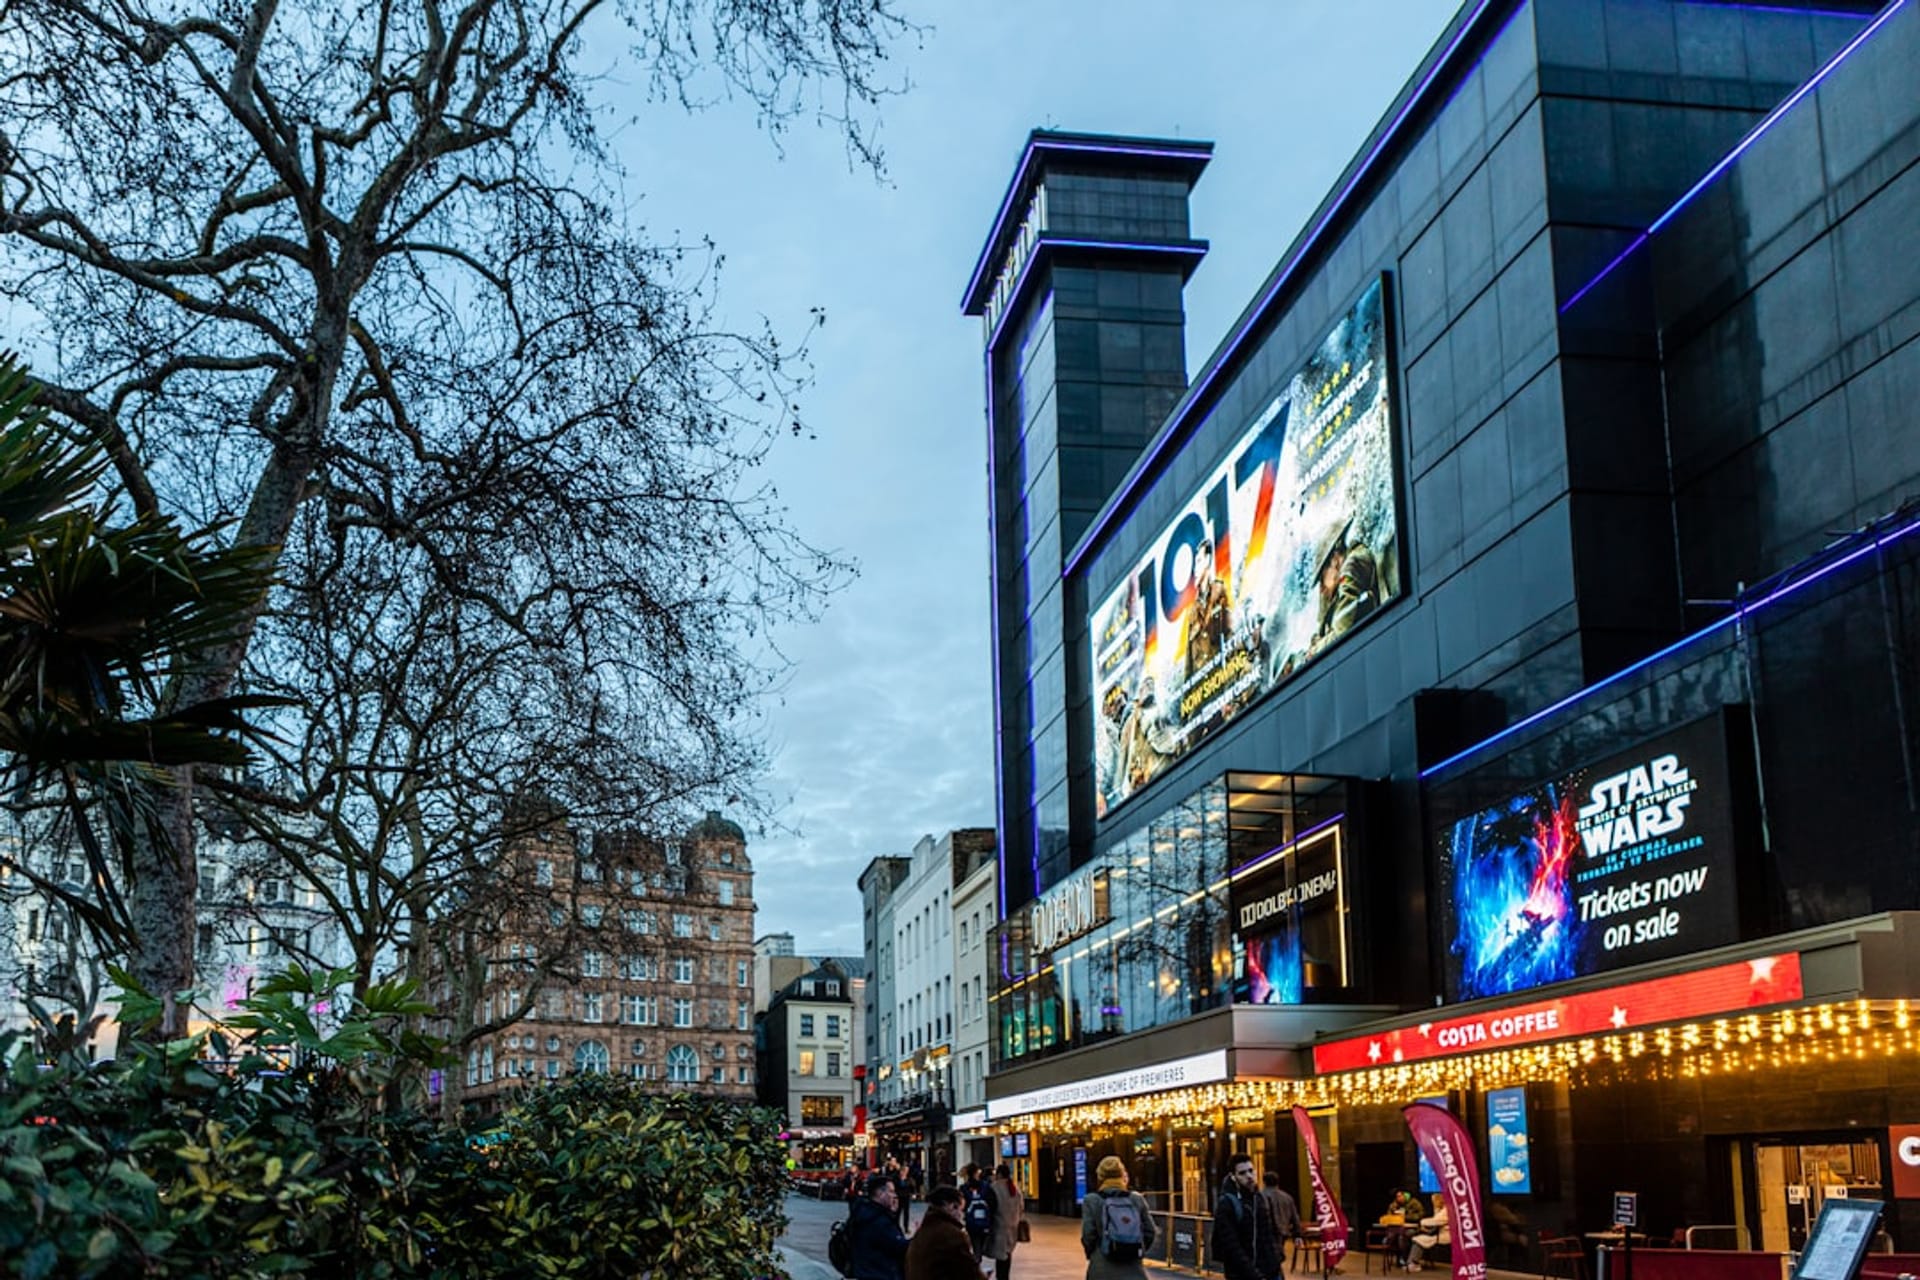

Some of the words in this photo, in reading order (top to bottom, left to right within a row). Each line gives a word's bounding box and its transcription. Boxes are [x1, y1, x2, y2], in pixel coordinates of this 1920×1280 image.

[1138, 398, 1293, 667] 1917
[1579, 754, 1688, 819] STAR
[1619, 804, 1633, 816] OF
[1635, 779, 1698, 810] SKYWALKER
[1581, 793, 1690, 859] WARS
[1255, 886, 1293, 921] DOLBY
[1579, 881, 1652, 922] Tickets
[1654, 866, 1708, 902] now
[1603, 924, 1632, 951] on
[1633, 907, 1680, 943] sale
[1438, 1023, 1487, 1048] COSTA
[1491, 1010, 1559, 1040] COFFEE
[1107, 1078, 1128, 1094] HOME
[1129, 1075, 1139, 1090] OF
[1140, 1066, 1185, 1088] PREMIERES
